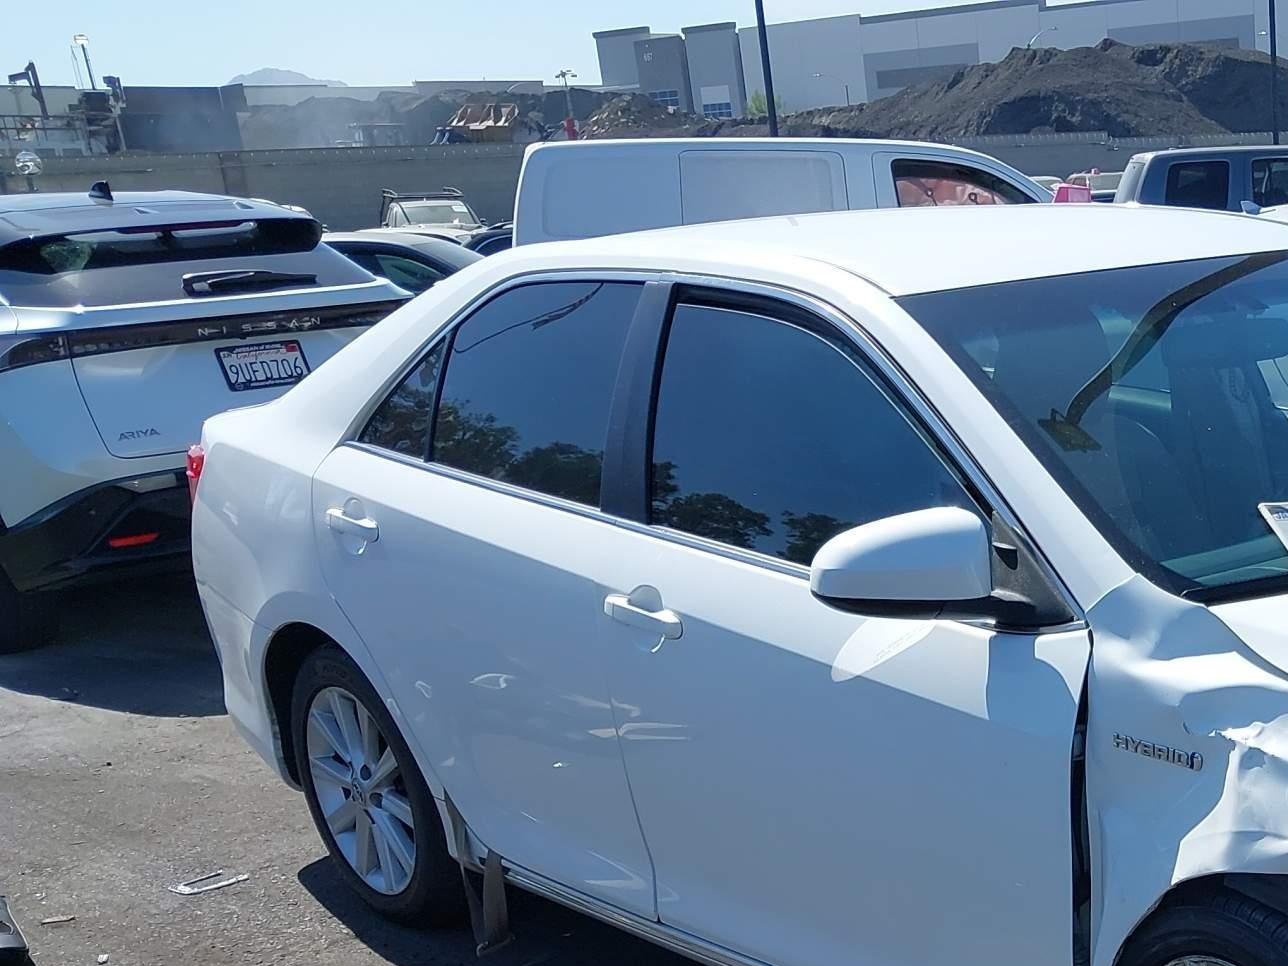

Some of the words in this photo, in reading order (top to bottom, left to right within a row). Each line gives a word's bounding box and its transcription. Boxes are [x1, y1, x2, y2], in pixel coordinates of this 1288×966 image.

[197, 316, 320, 337] NISSAN
[117, 428, 160, 441] ARIYA
[1112, 732, 1190, 769] HYBRID
